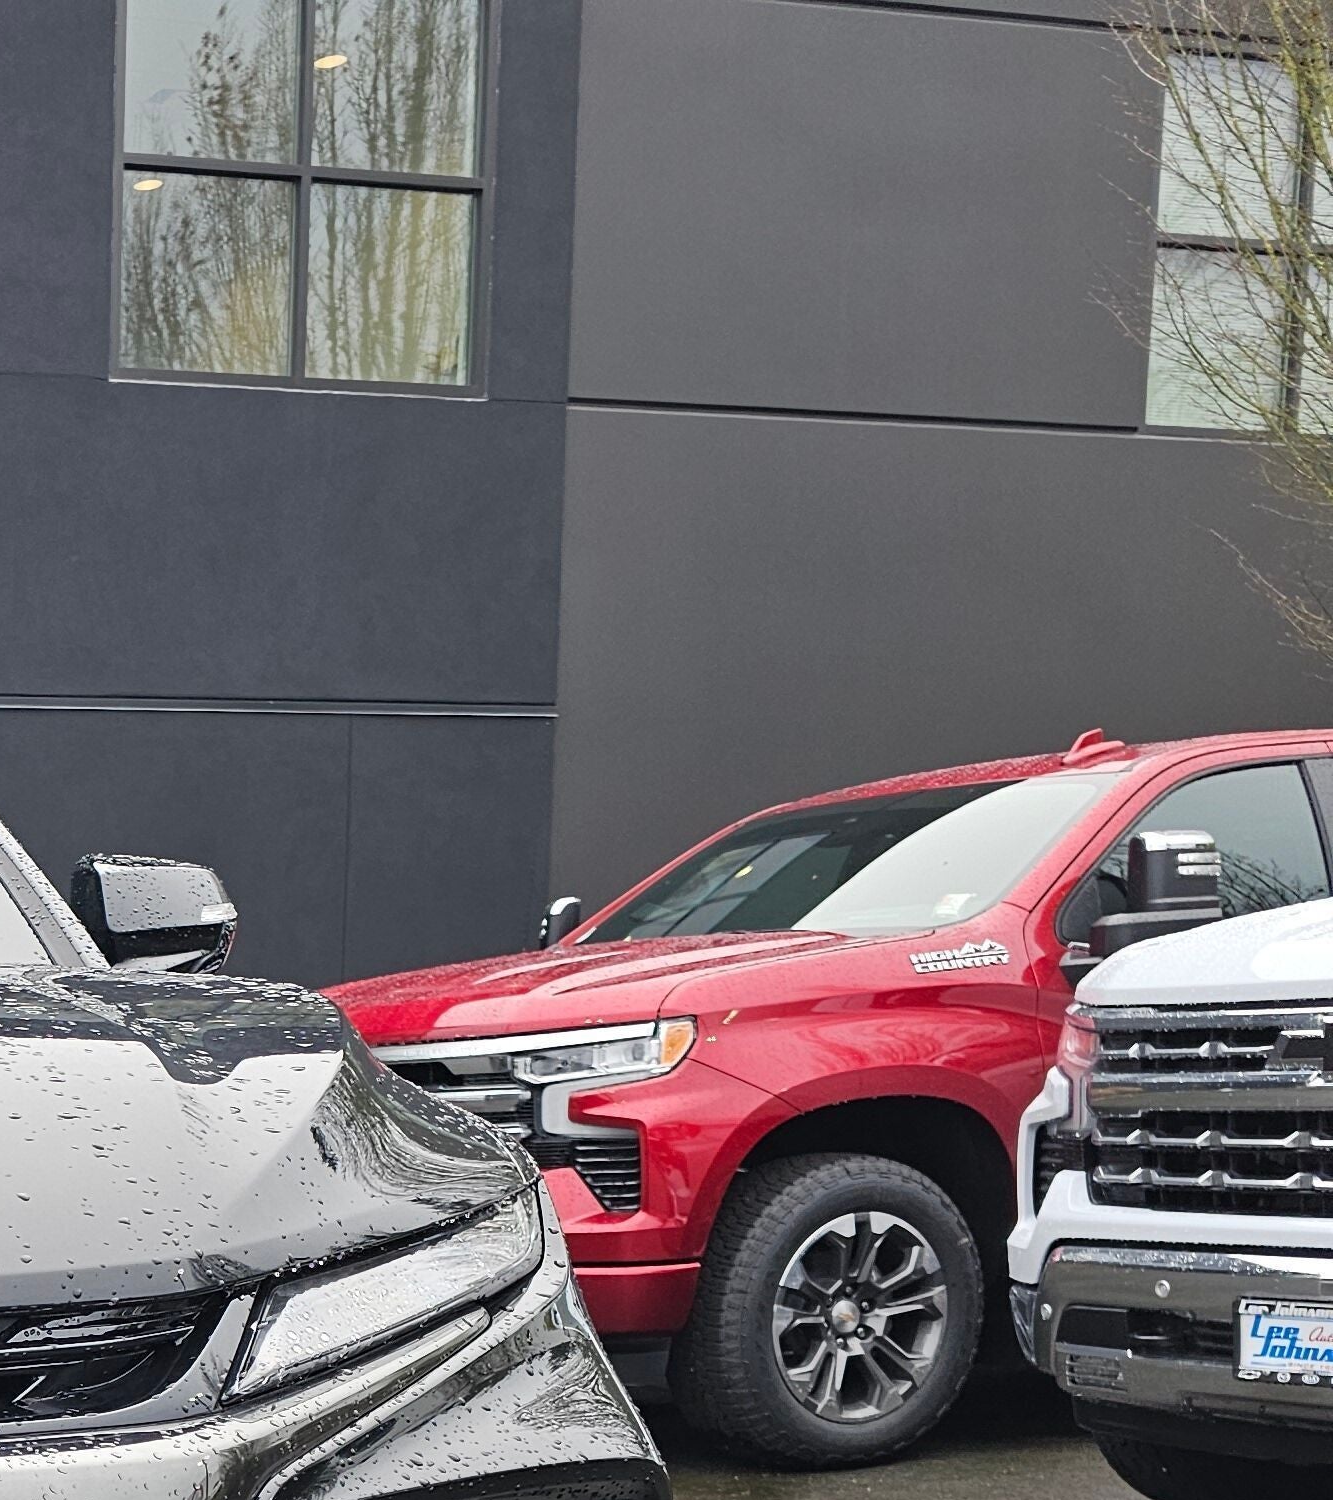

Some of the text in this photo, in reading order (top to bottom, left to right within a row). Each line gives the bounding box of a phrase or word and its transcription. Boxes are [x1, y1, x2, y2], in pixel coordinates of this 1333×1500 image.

[909, 949, 961, 964] HIGH
[914, 954, 1009, 973] COUNTRY
[1250, 1314, 1303, 1341] Lee
